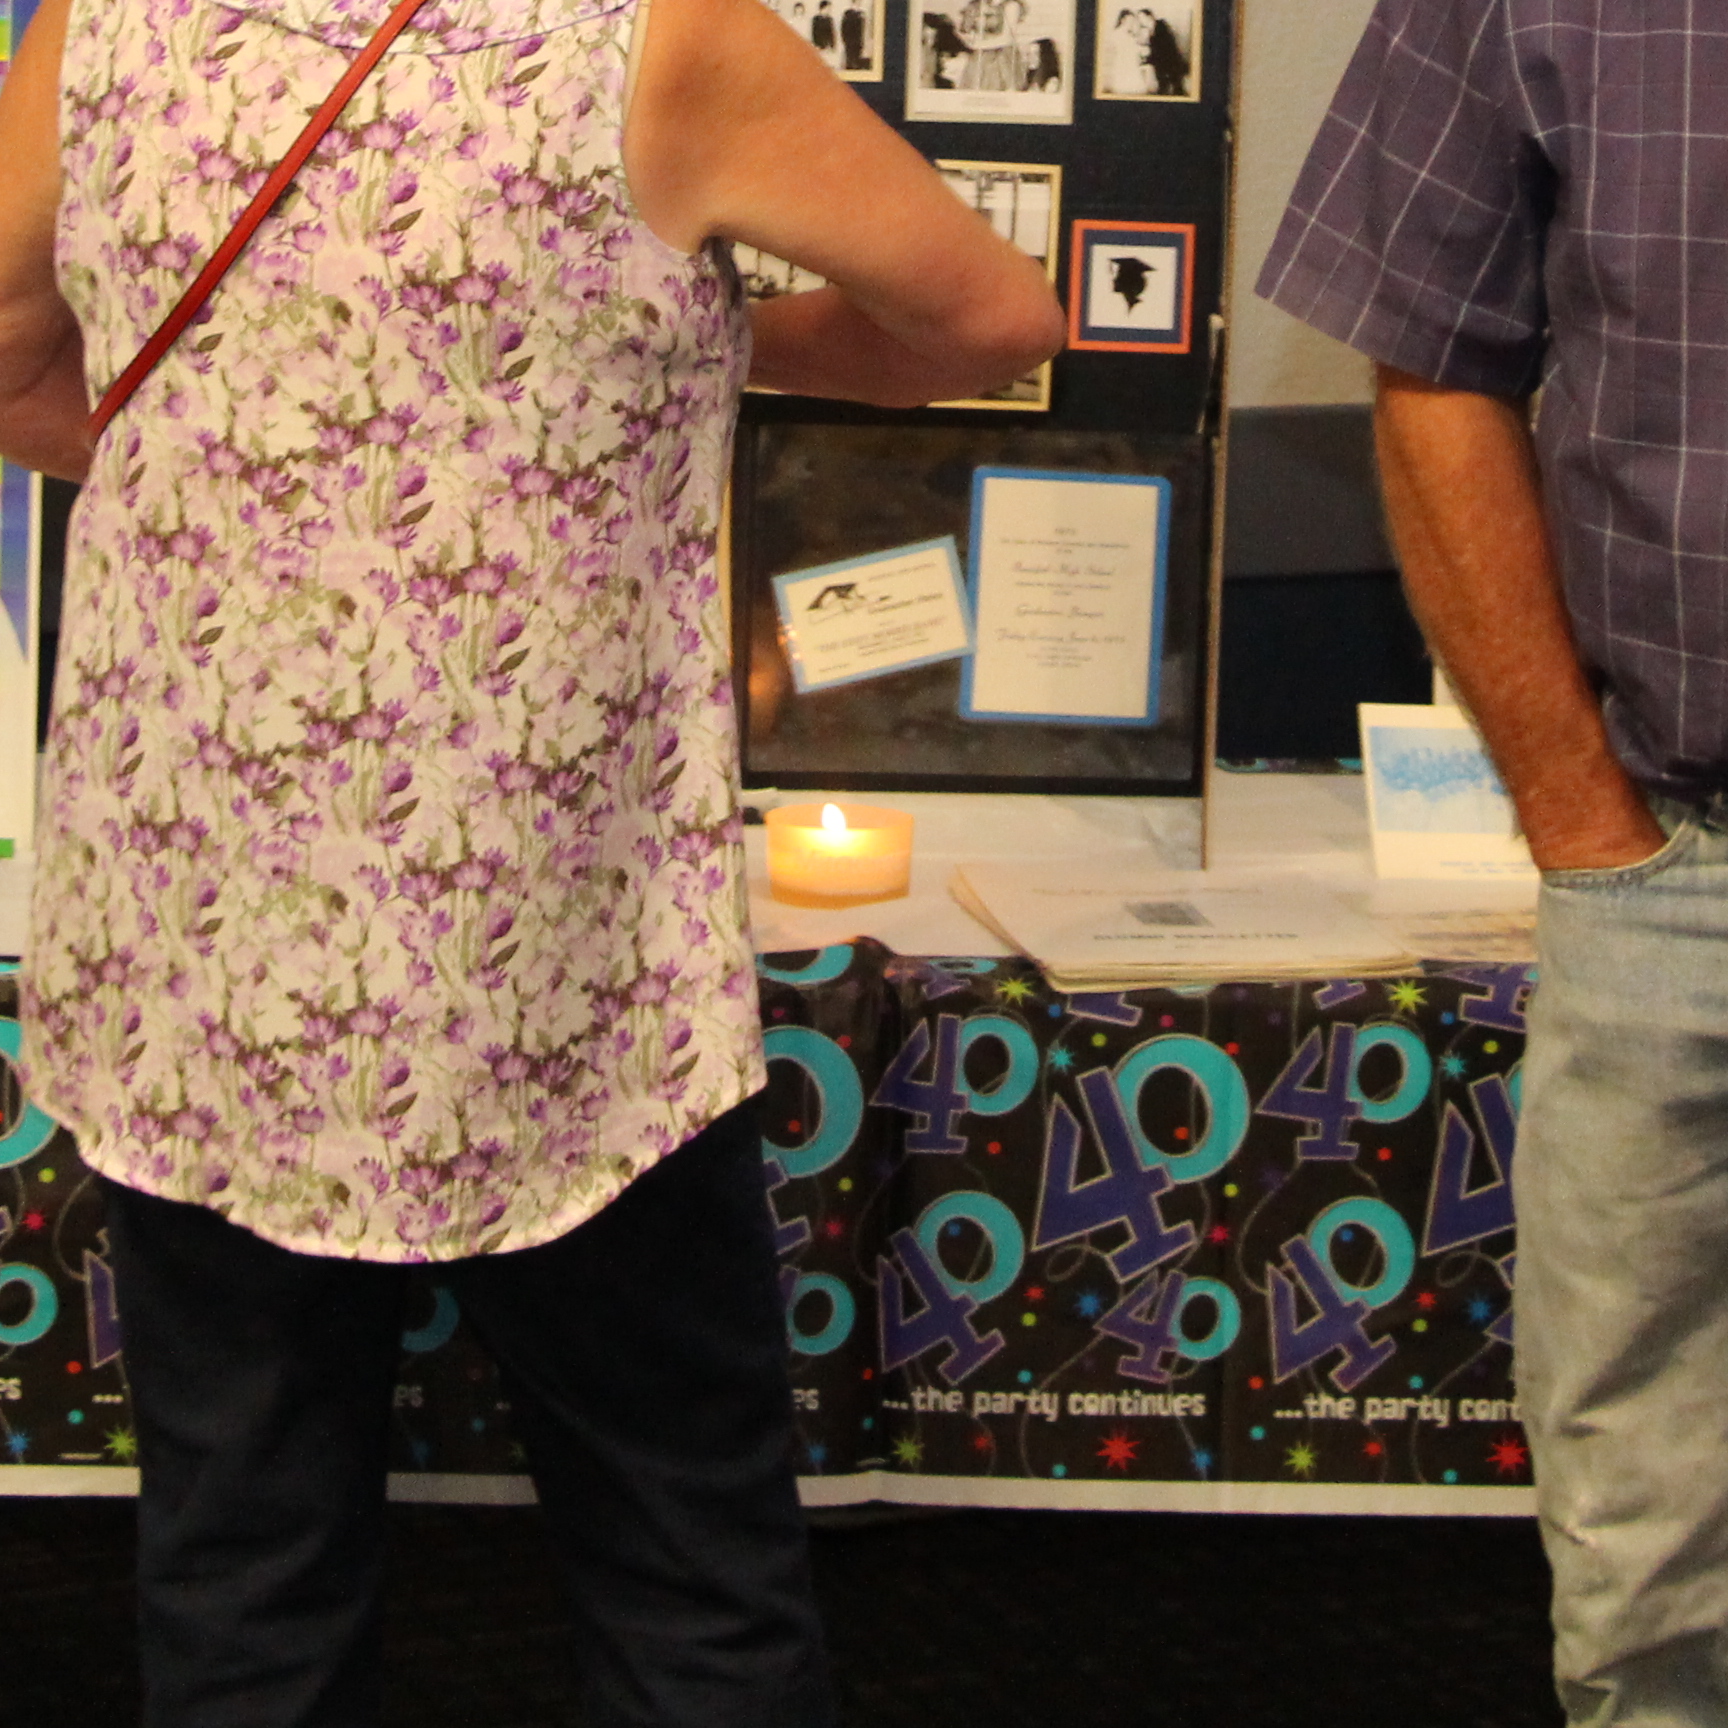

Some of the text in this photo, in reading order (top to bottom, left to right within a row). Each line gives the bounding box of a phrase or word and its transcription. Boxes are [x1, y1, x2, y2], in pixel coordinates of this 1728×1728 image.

[869, 1013, 1038, 1155] 40
[1256, 1022, 1432, 1162] 40
[1032, 1033, 1251, 1283] 40
[877, 1190, 1025, 1386] 40
[1094, 1270, 1241, 1383] 40
[1268, 1195, 1416, 1393] 40
[974, 1388, 1059, 1422] party
[1068, 1389, 1206, 1417] continues
[1363, 1395, 1450, 1429] party
